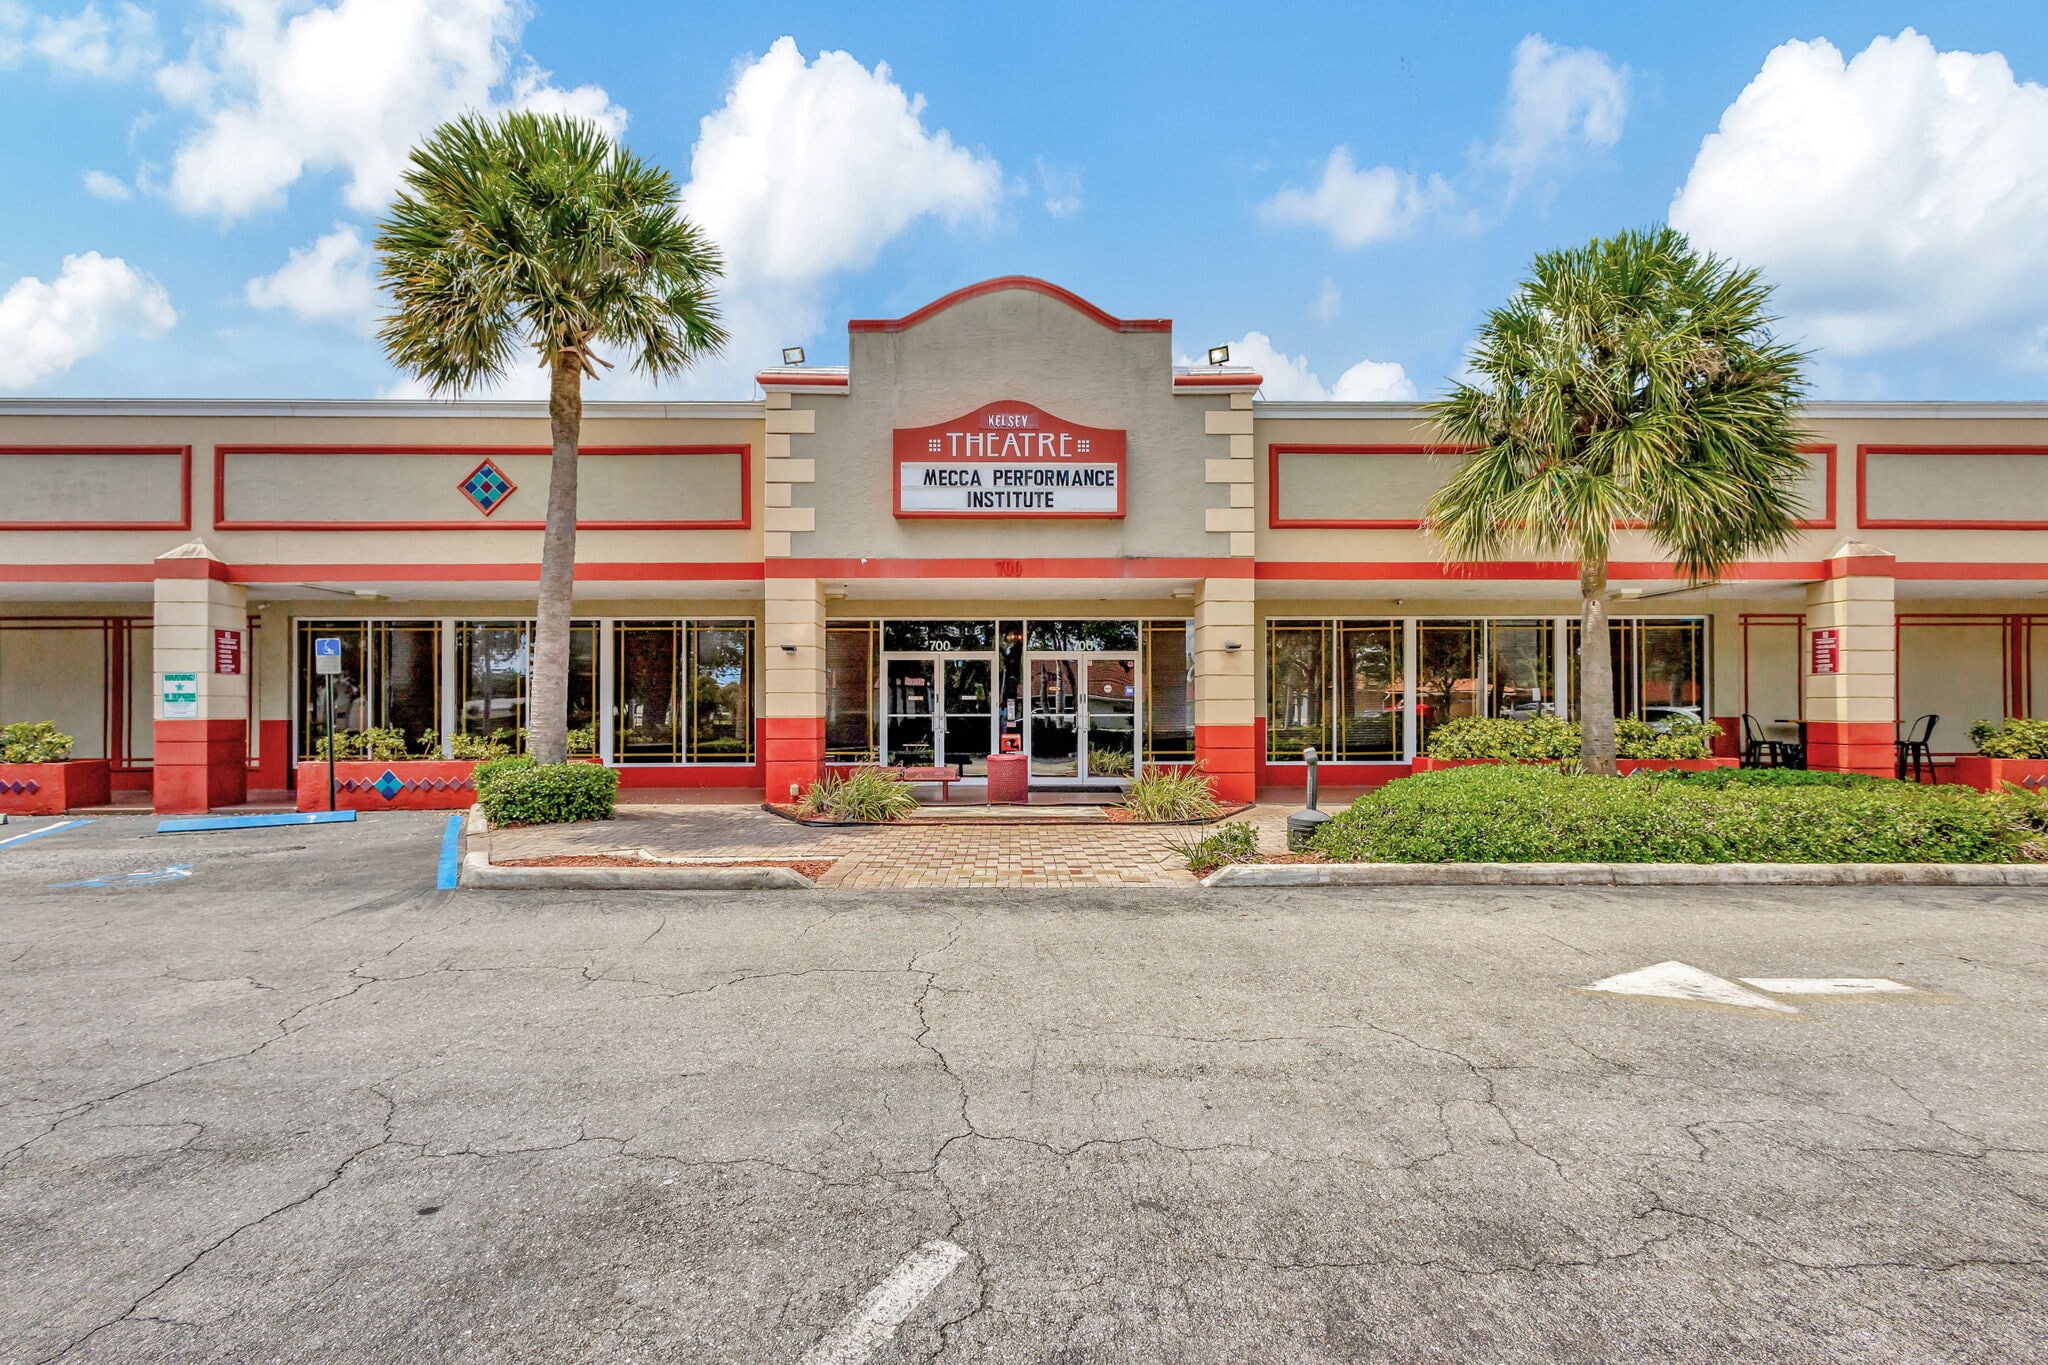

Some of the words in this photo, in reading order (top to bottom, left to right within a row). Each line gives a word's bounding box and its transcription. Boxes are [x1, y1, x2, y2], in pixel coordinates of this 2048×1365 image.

[988, 414, 1028, 428] KELSEY
[946, 432, 1072, 457] THEATRE
[923, 469, 982, 486] MECCA
[993, 469, 1115, 486] PERFORMANCE
[967, 491, 1054, 508] INSTITUTE
[995, 560, 1023, 577] 700
[929, 640, 951, 651] 700
[1073, 640, 1094, 651] 700
